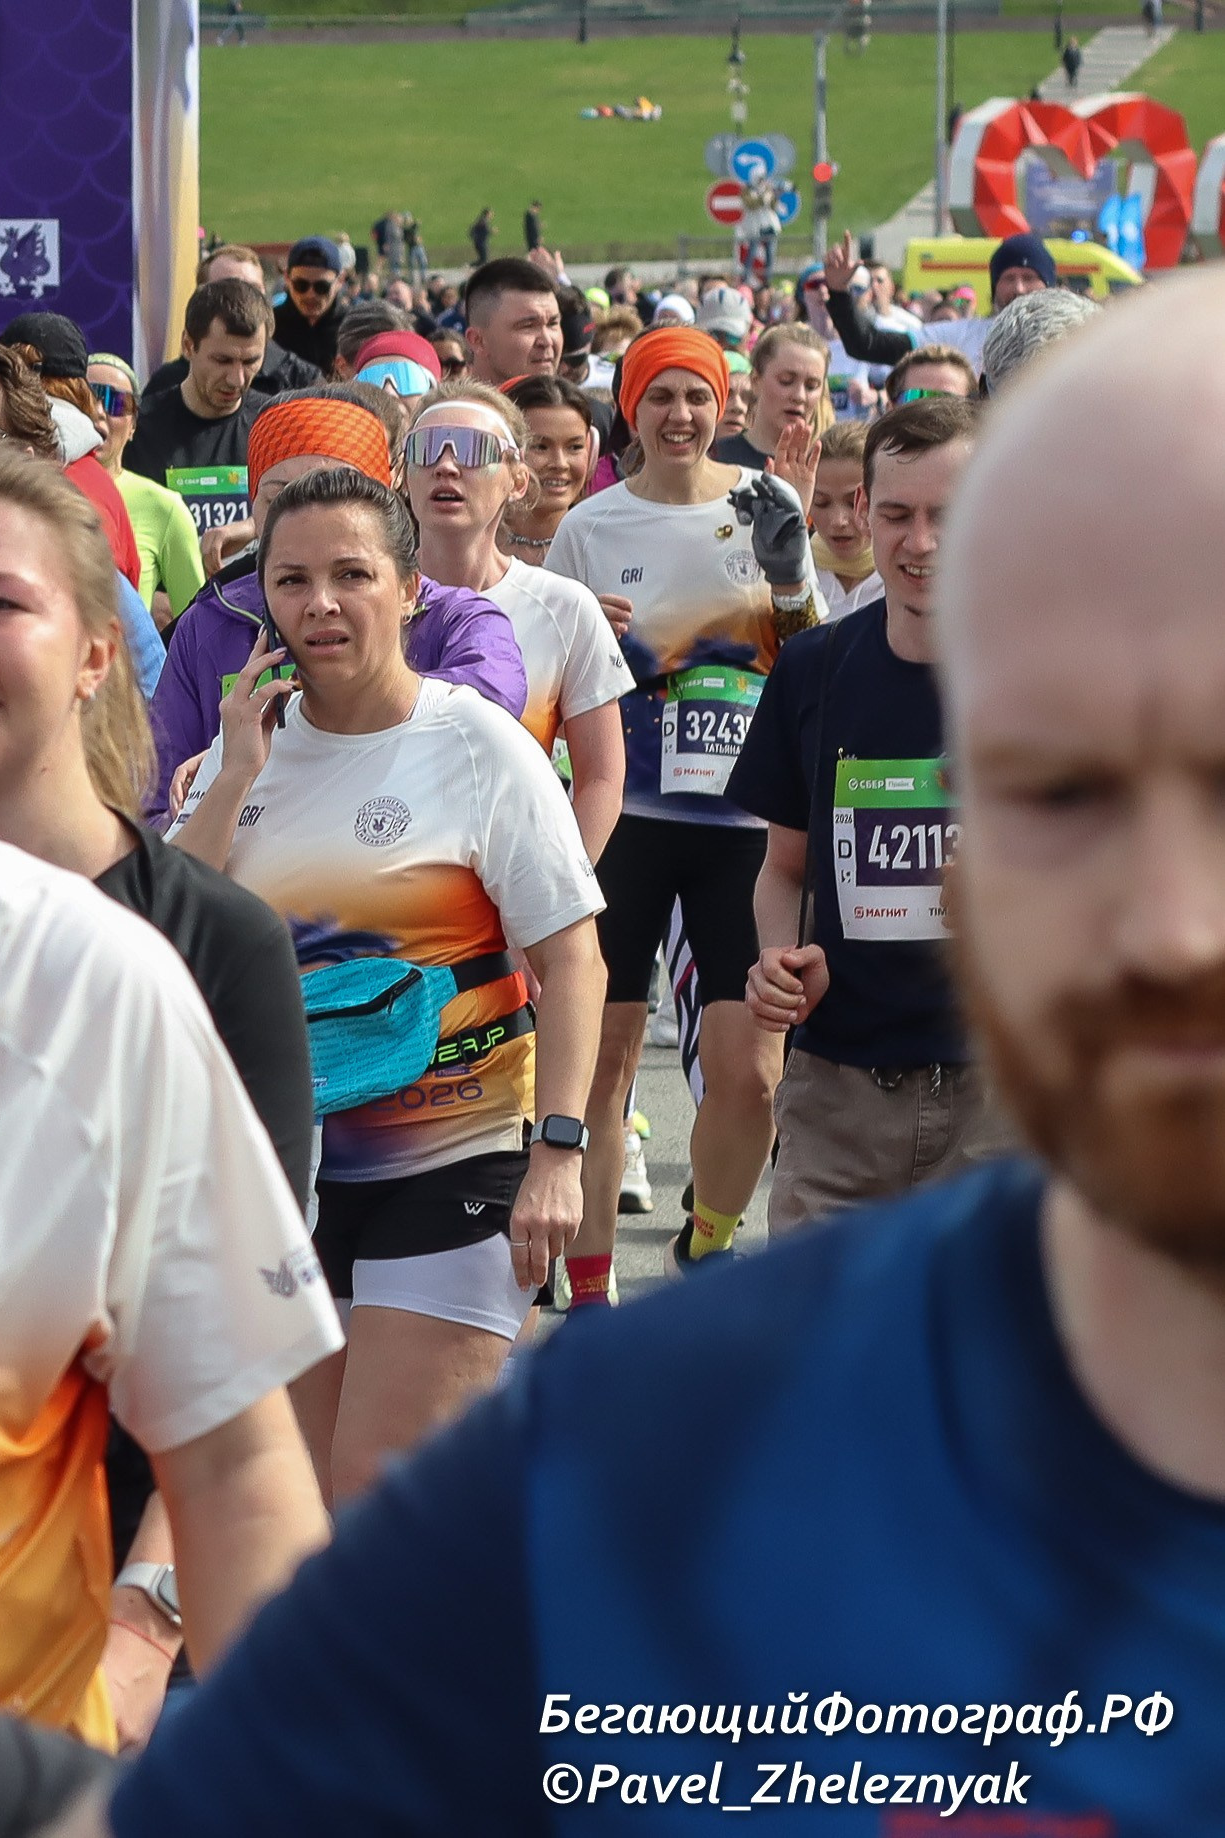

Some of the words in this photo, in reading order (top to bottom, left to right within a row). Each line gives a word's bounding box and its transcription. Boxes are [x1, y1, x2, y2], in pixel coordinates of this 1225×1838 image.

[189, 501, 249, 528] 31321
[664, 721, 675, 737] D
[685, 710, 753, 745] 3243
[859, 780, 885, 789] СБЕР
[238, 804, 266, 827] GRi
[835, 813, 853, 824] 2026
[838, 838, 852, 859] D
[865, 908, 908, 918] МАГНИТ
